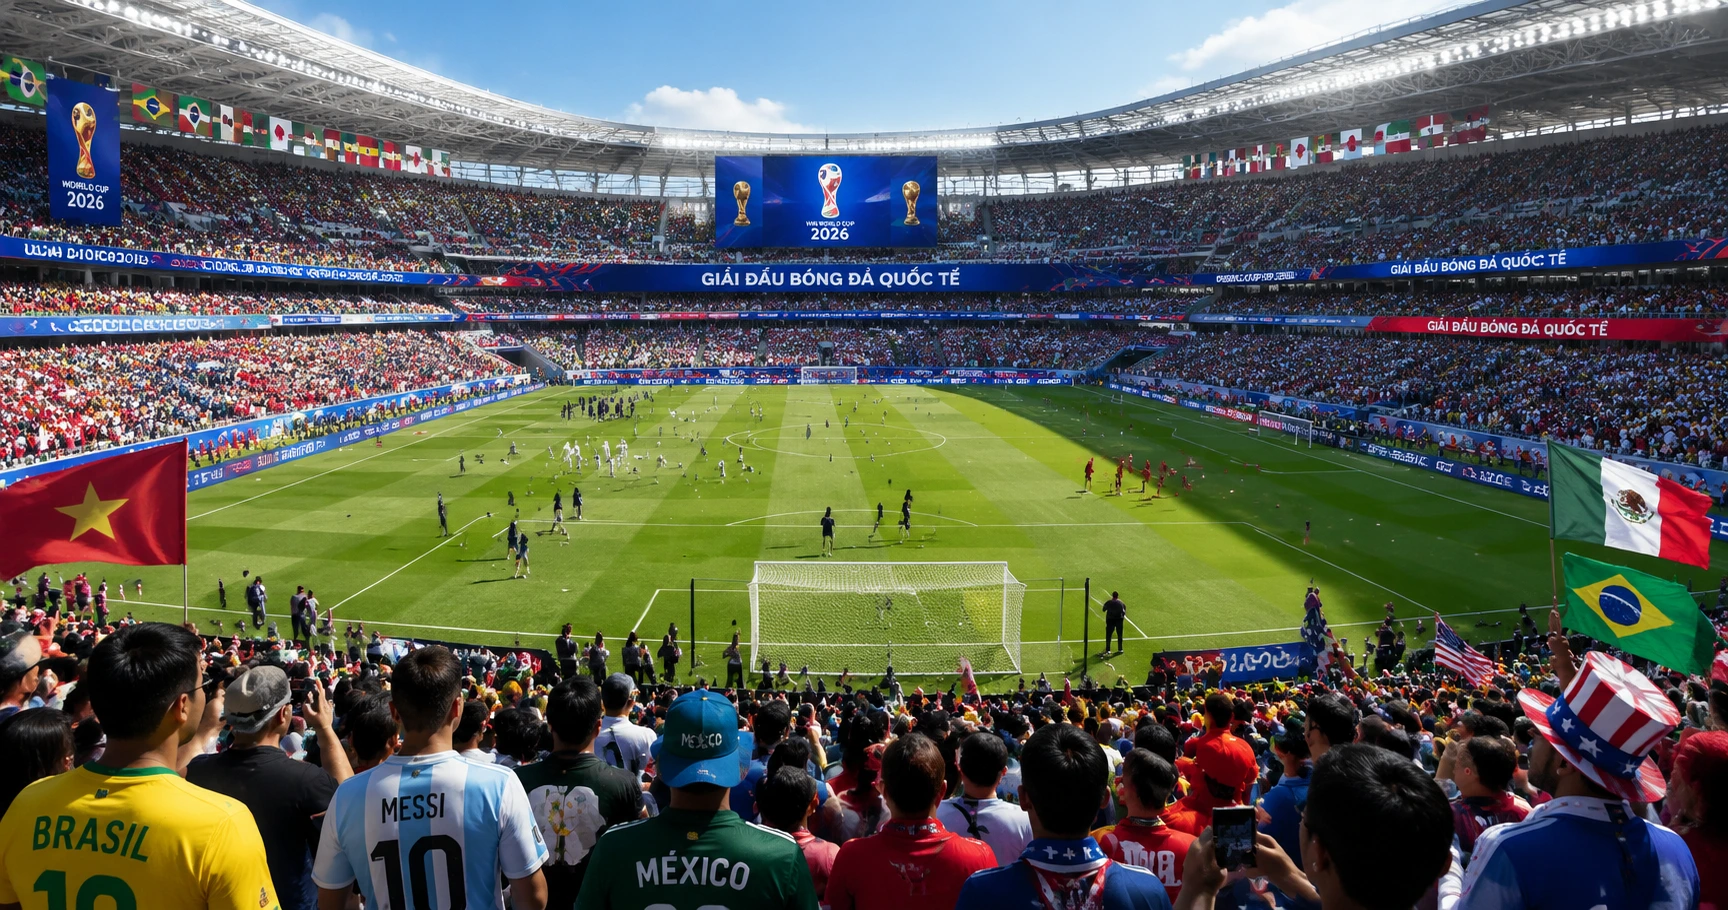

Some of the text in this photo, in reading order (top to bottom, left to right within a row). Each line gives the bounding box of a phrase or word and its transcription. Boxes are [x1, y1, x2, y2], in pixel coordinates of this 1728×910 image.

[95, 185, 109, 193] CUP
[67, 191, 104, 210] 2026
[811, 227, 849, 240] 2026
[1441, 258, 1476, 272] BÓNG
[790, 268, 843, 286] BÓNG
[879, 266, 933, 288] QUỐC
[938, 267, 960, 286] TẾ
[1480, 319, 1518, 334] BÓNG
[381, 793, 445, 824] MESSI
[32, 815, 149, 862] BRASIL
[371, 835, 467, 910] 10
[636, 850, 750, 891] MÉXICO
